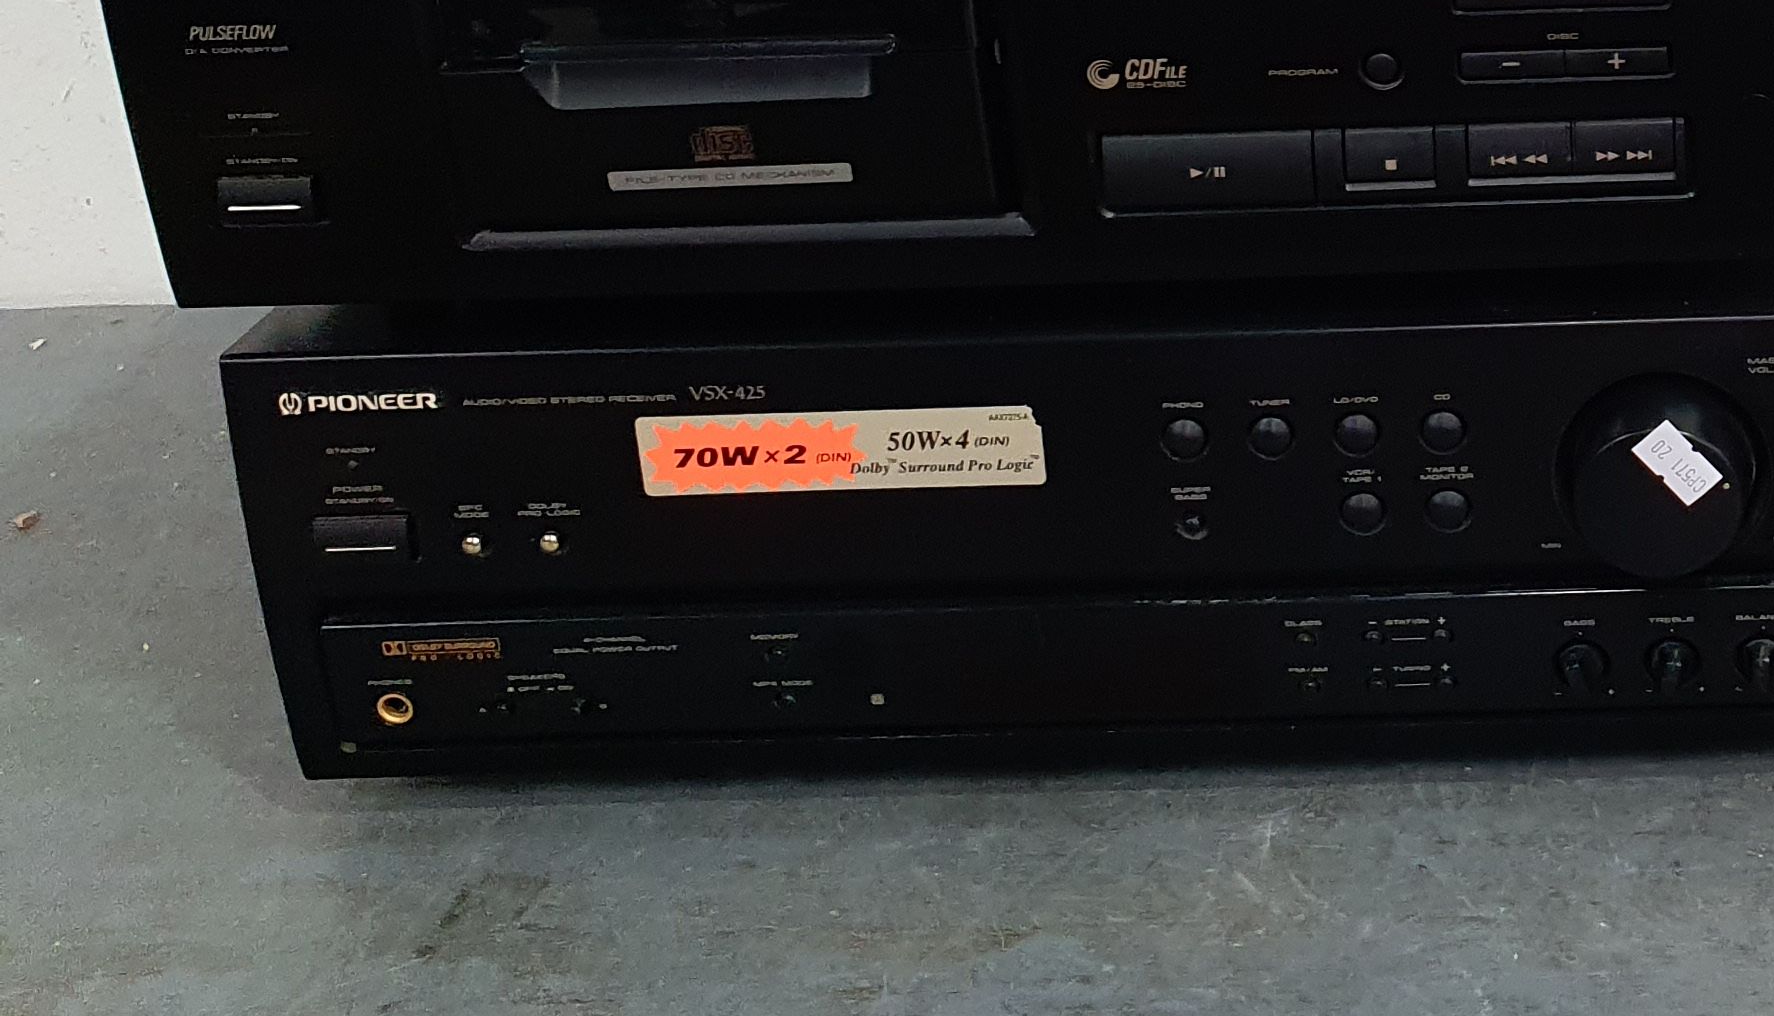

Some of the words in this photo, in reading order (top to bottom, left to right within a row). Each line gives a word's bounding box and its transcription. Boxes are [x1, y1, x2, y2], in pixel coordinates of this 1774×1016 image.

[188, 24, 278, 42] PULSEFLOW
[688, 385, 767, 402] VSX-425
[307, 392, 440, 414] PIONEER
[974, 436, 1010, 448] (DIN)
[815, 452, 852, 464] (DIN)
[849, 461, 891, 476] Dolby
[898, 459, 966, 474] Surround
[967, 459, 993, 472] Pro
